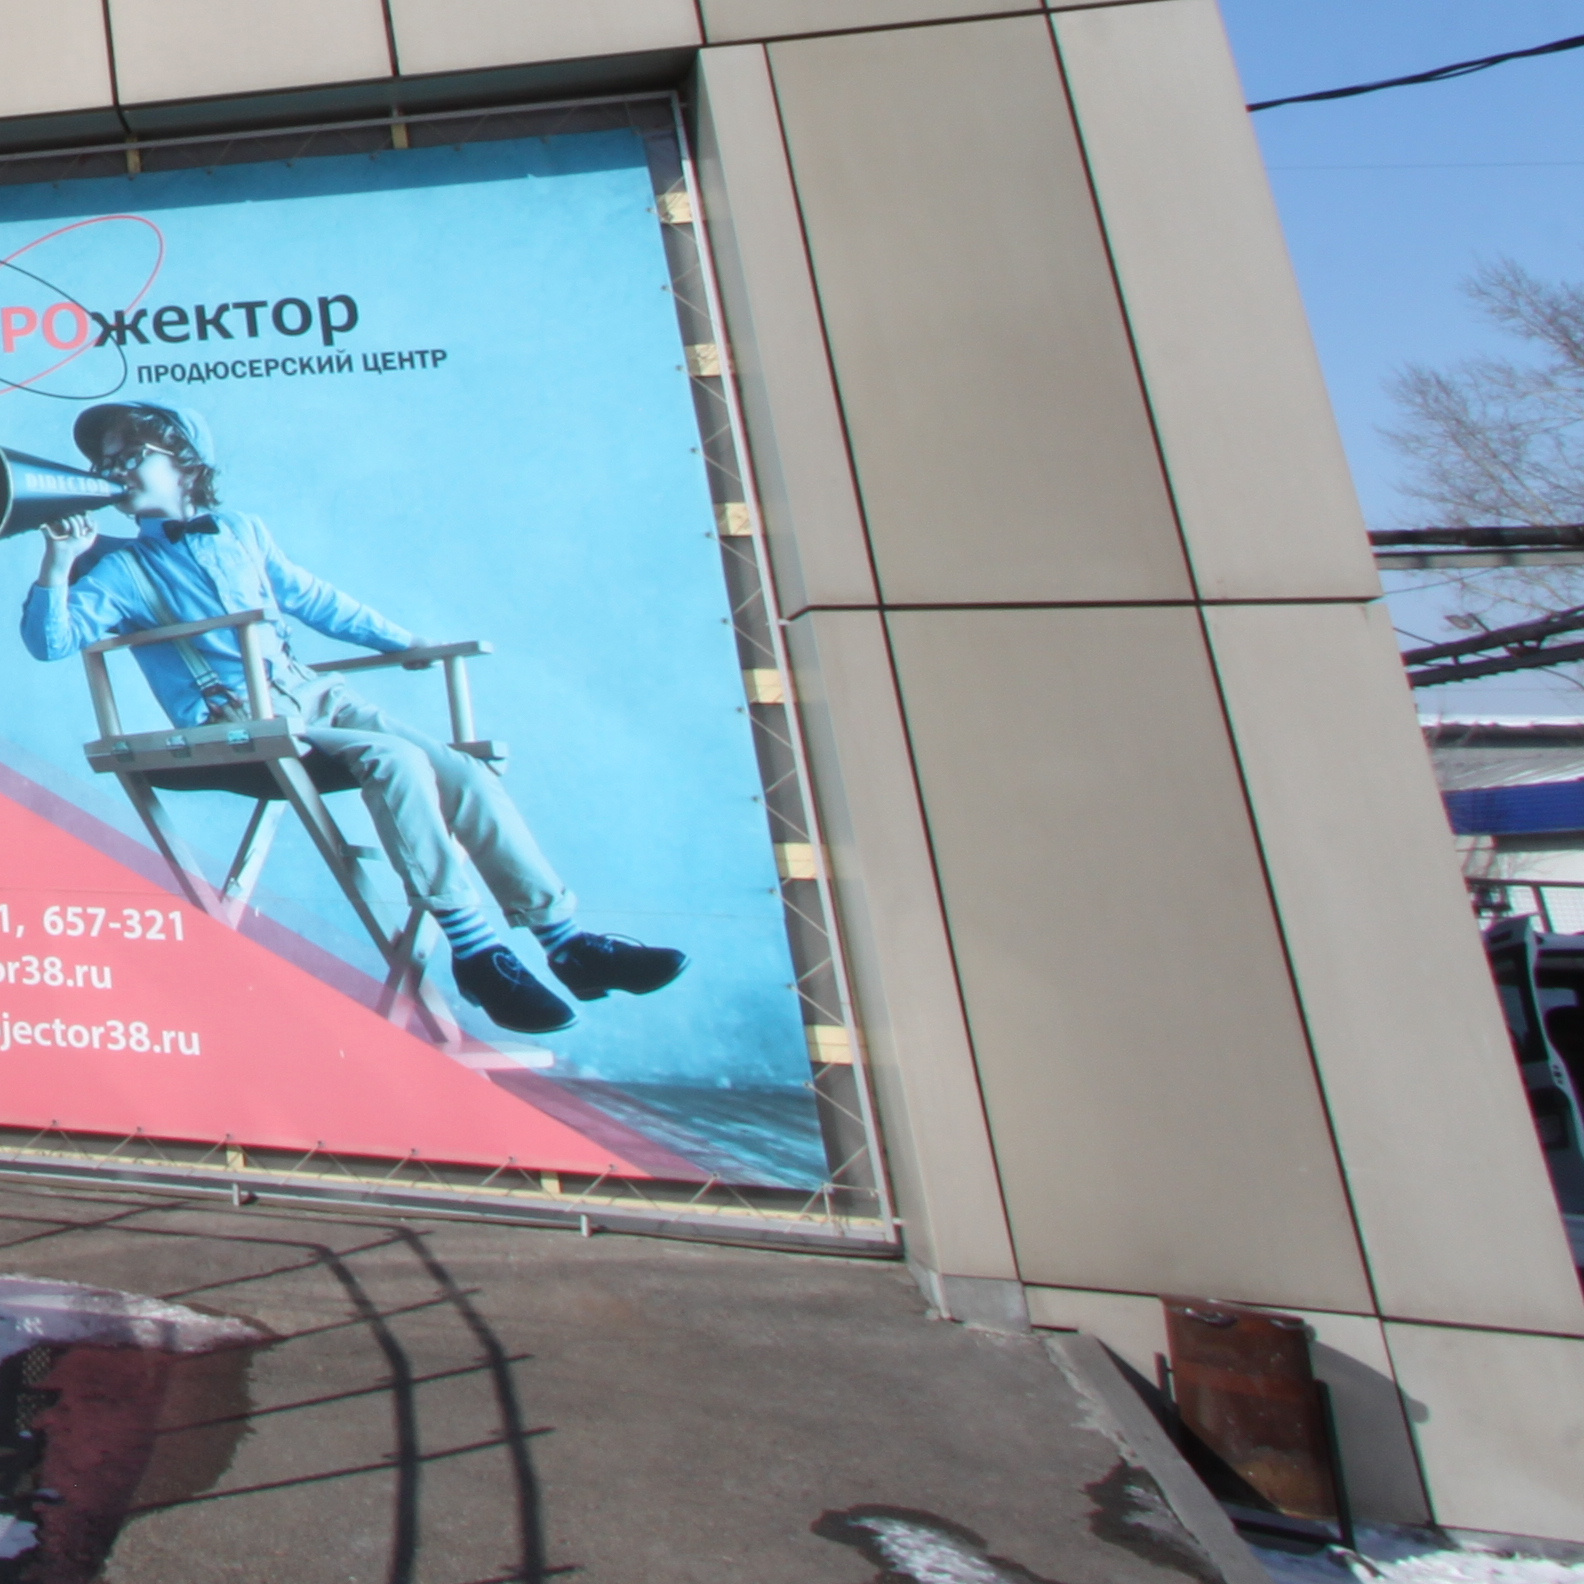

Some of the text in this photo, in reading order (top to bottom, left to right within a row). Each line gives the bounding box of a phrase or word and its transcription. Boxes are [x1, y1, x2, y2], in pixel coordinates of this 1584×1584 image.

[137, 347, 449, 384] ПРОДЮСЕРСКИЙ ЦЕНТР
[42, 905, 185, 942] 657-321
